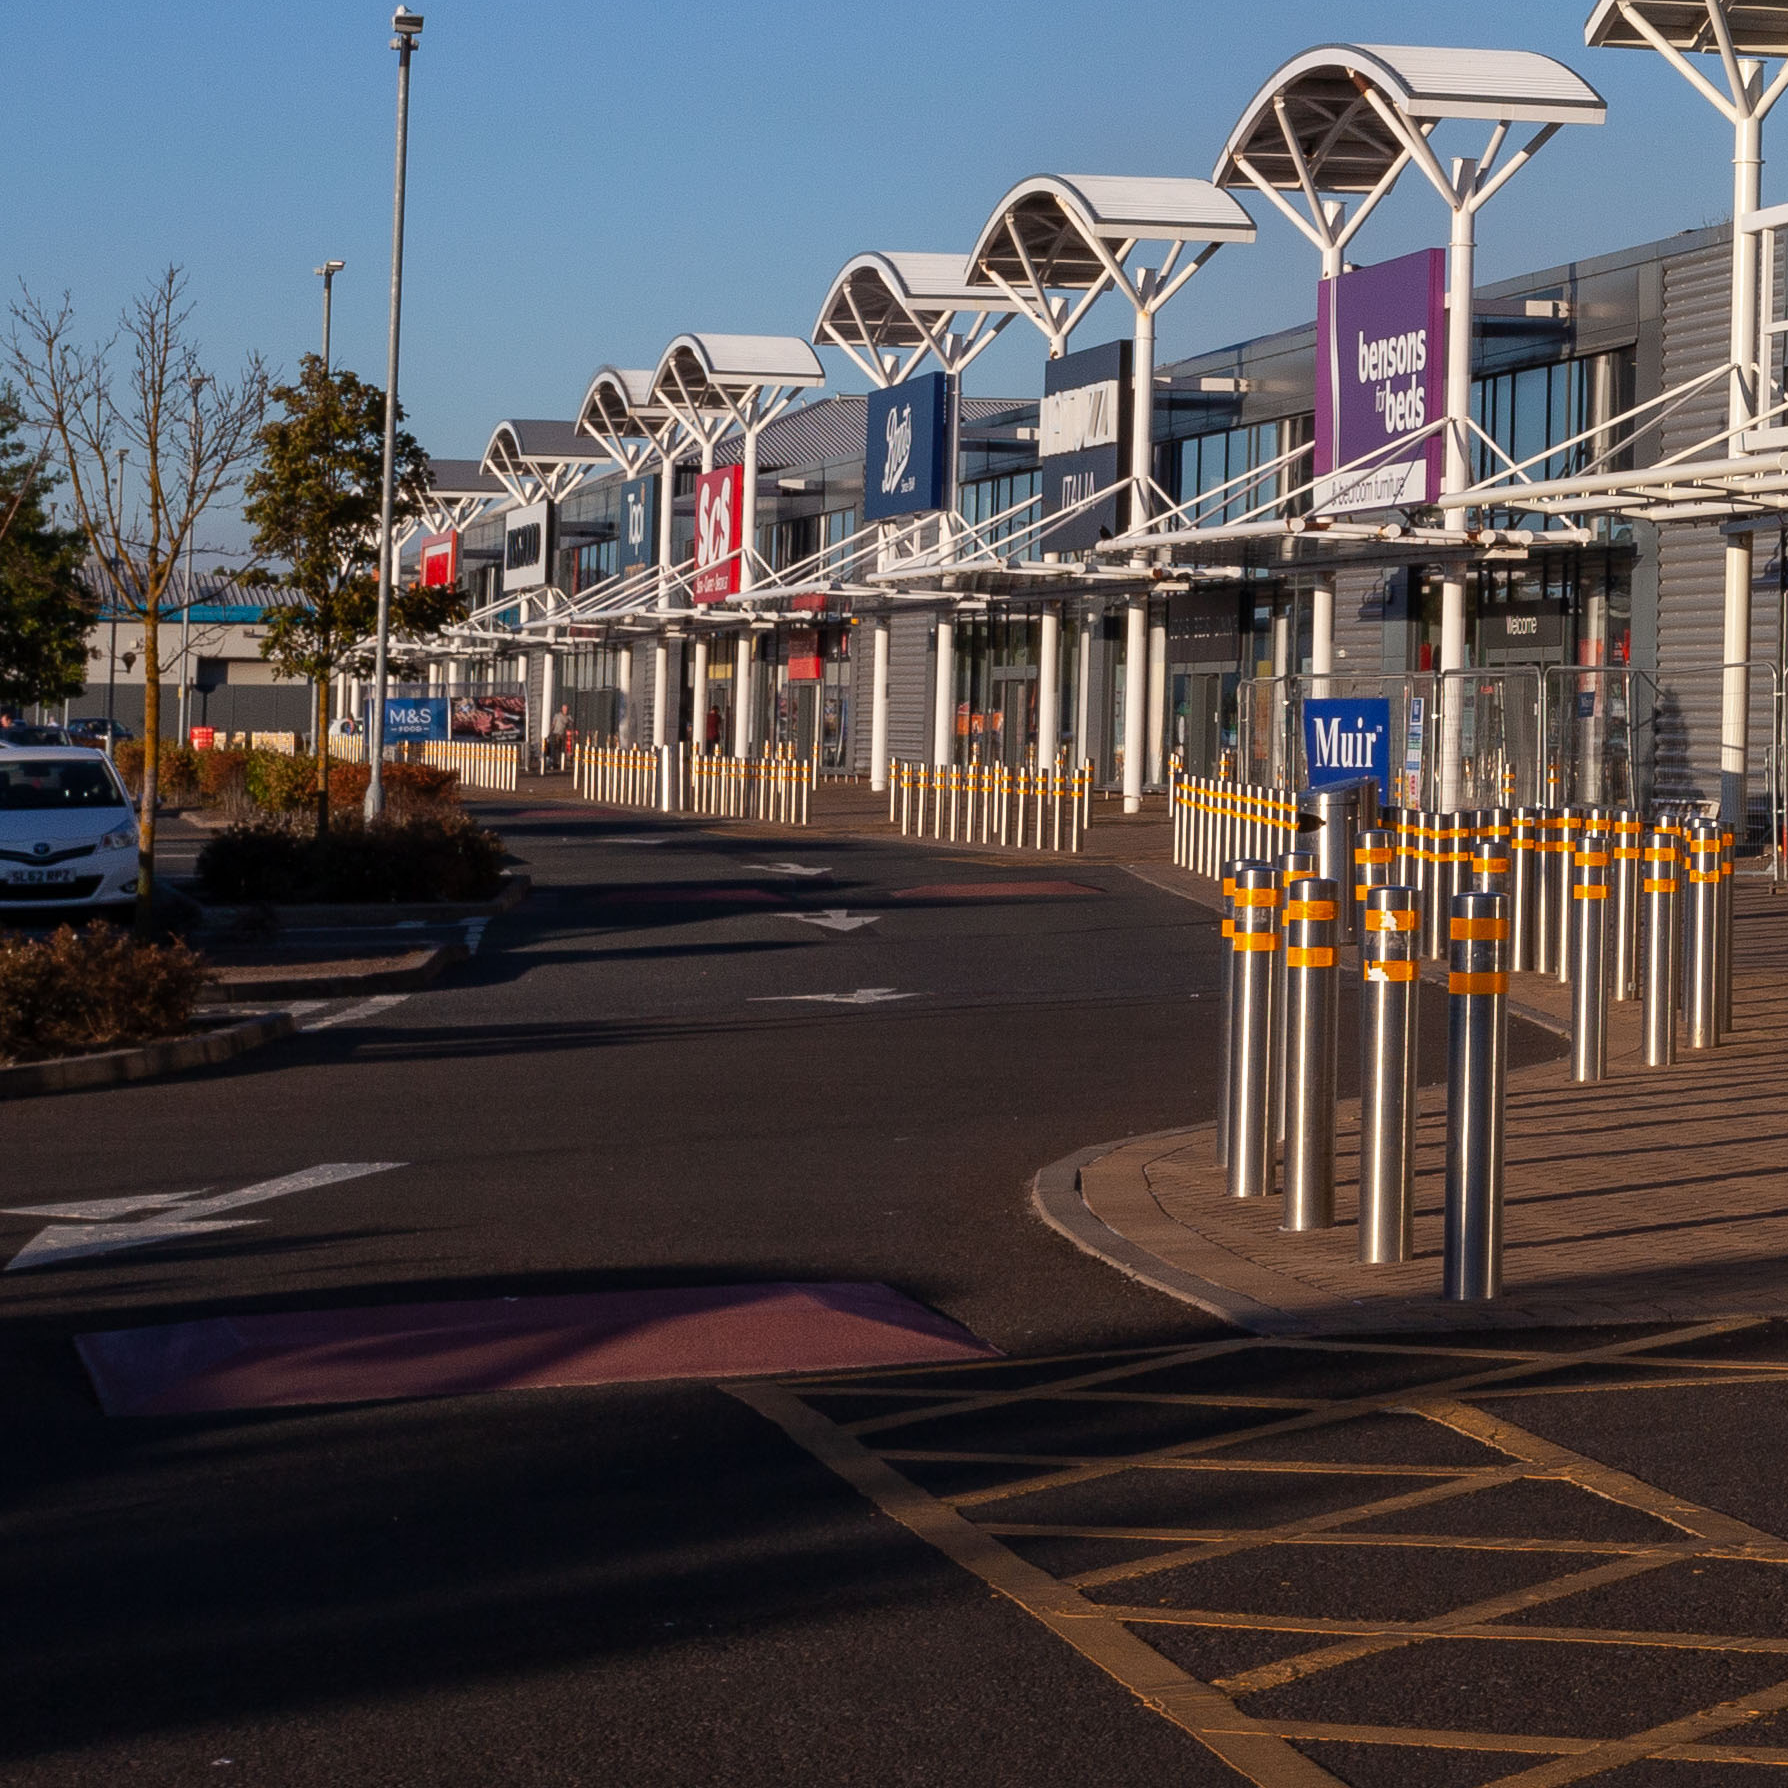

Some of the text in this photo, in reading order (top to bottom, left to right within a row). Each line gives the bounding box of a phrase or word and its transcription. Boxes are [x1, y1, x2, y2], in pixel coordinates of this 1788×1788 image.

[1358, 329, 1427, 384] bensons
[1375, 374, 1426, 434] for beds
[1506, 615, 1538, 635] Welcome
[390, 708, 431, 725] M&S
